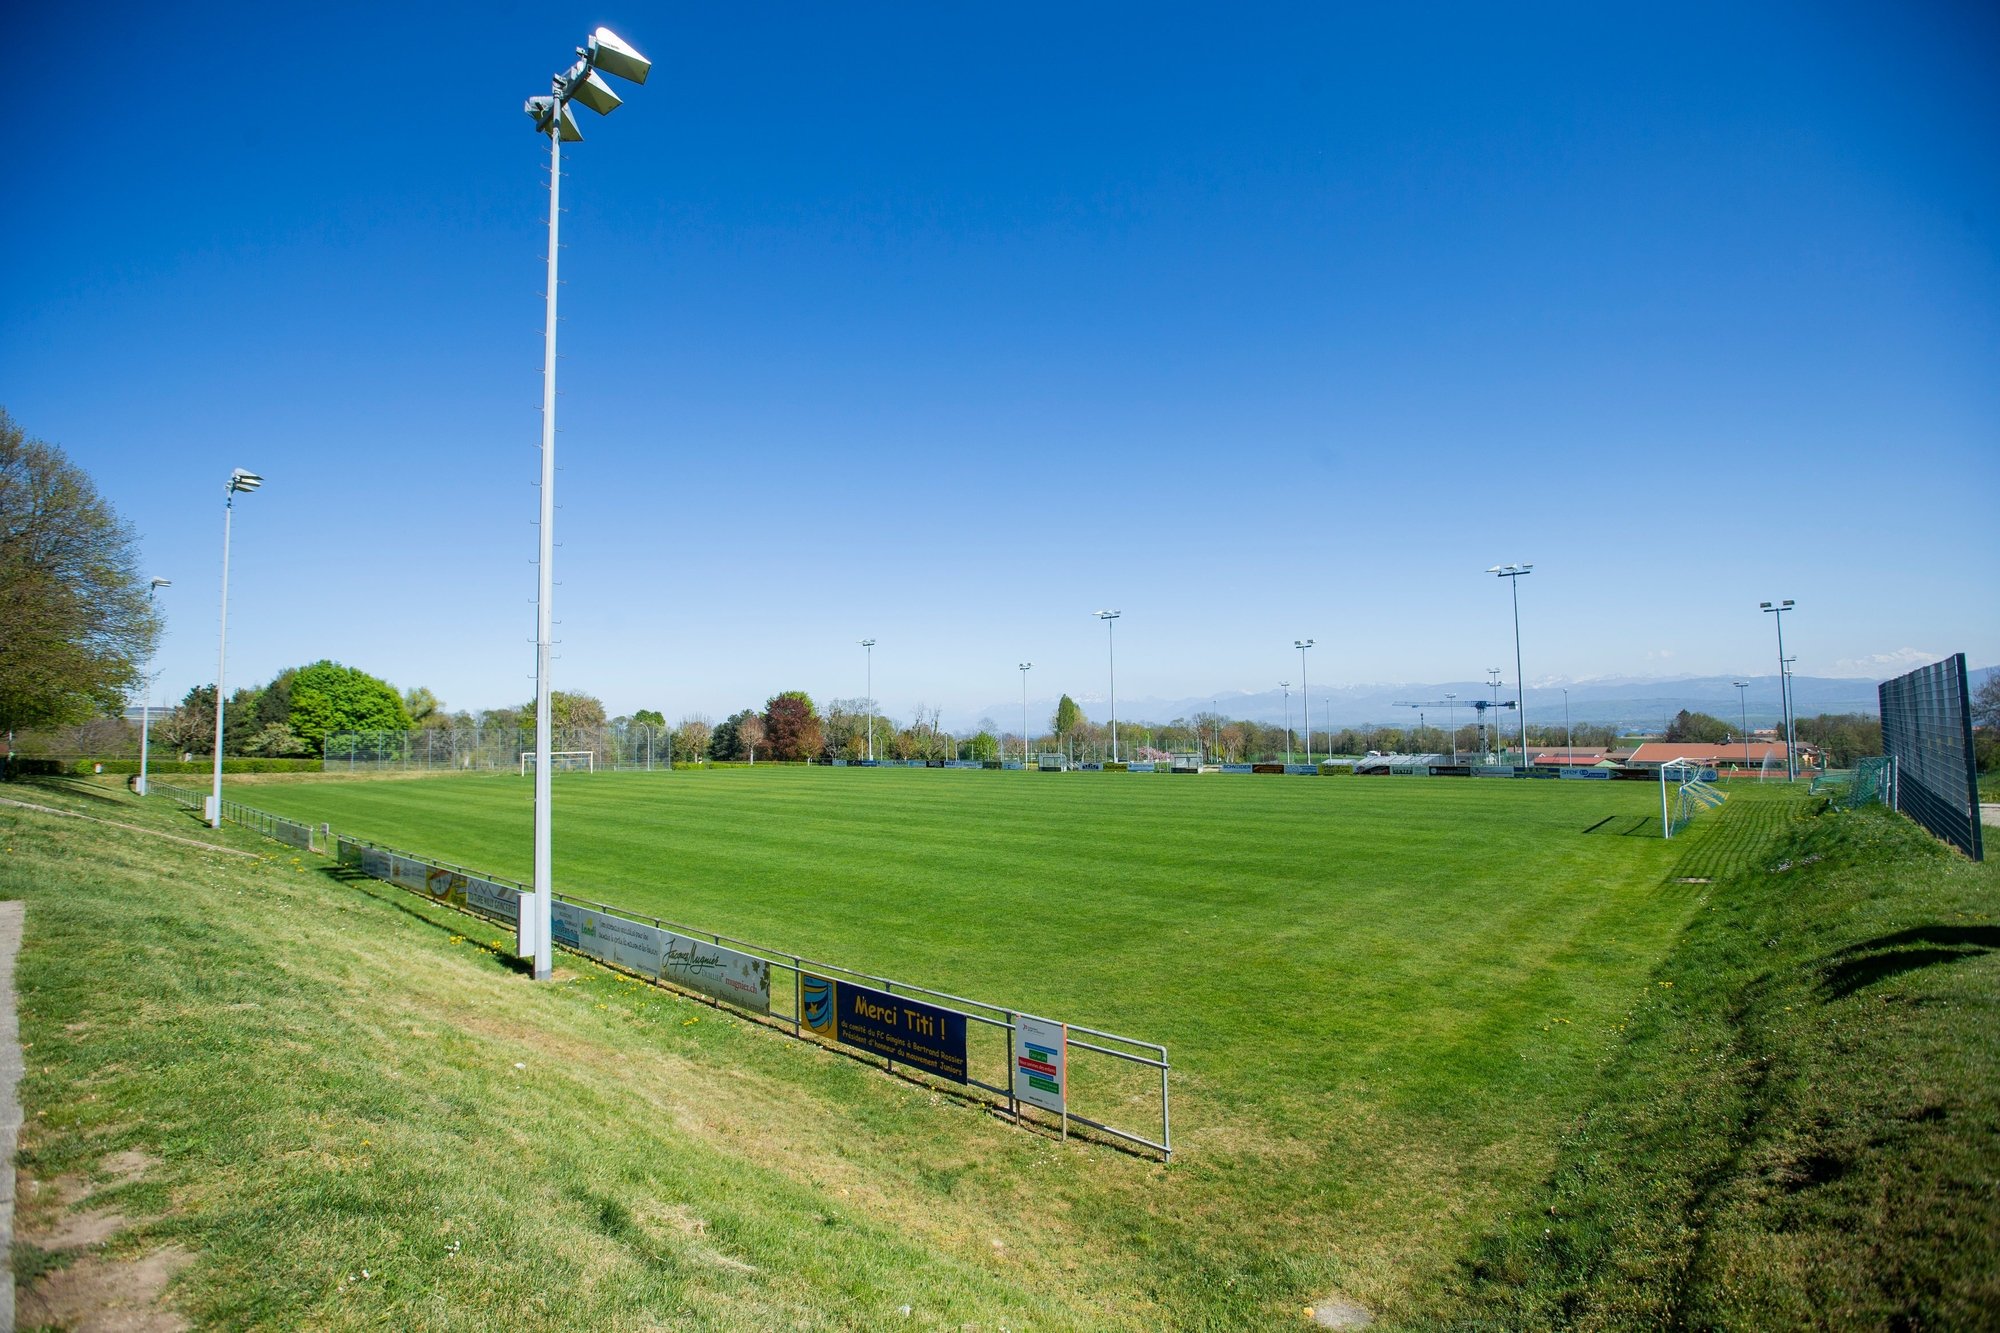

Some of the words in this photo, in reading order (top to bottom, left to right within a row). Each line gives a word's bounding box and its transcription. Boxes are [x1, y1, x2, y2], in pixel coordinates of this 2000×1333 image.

[854, 995, 897, 1026] Merci
[903, 1009, 934, 1037] Titi
[941, 1017, 946, 1040] !
[876, 1030, 885, 1039] FC
[912, 1041, 940, 1058] Bertrand
[897, 1048, 905, 1056] du
